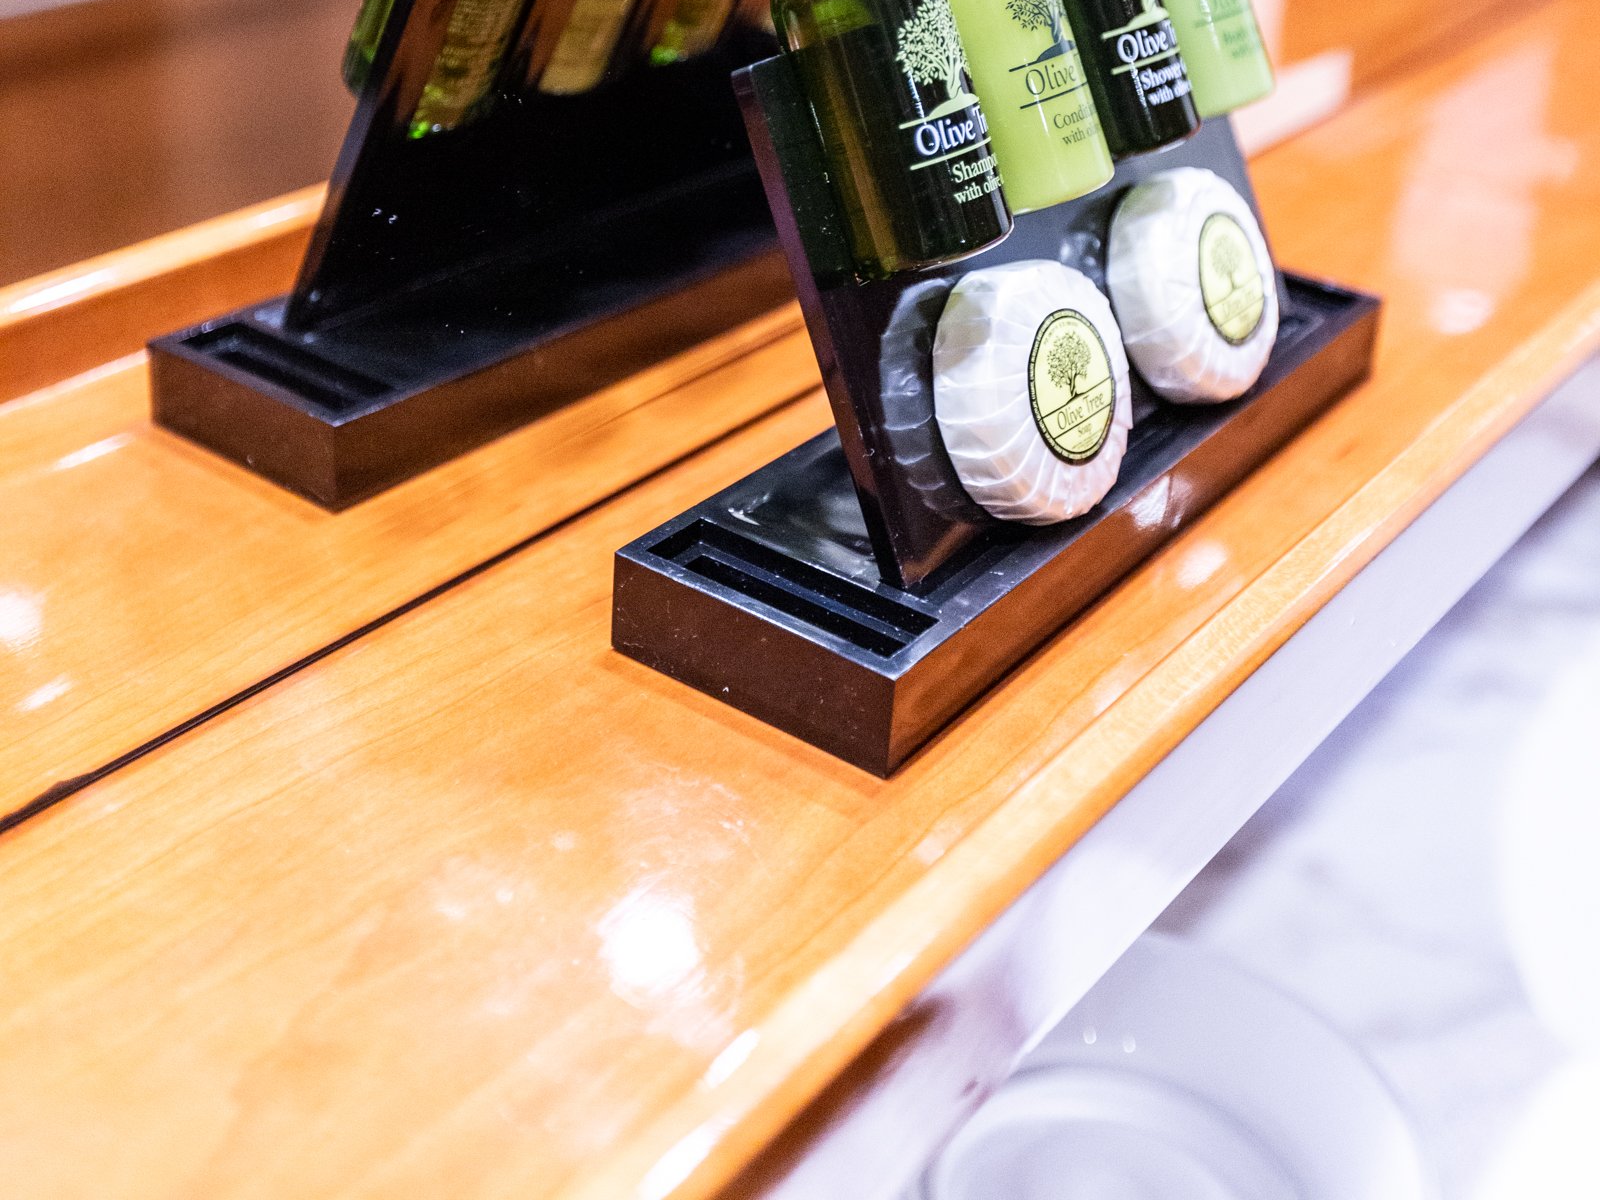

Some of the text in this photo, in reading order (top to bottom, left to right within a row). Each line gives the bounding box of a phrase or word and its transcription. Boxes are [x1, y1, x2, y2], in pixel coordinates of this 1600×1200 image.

[1117, 30, 1169, 63] Olive
[1025, 64, 1077, 95] Olive
[1139, 62, 1182, 90] Shower
[1148, 85, 1175, 106] with
[915, 118, 976, 155] Olive
[1062, 128, 1087, 145] with
[953, 182, 983, 204] with
[1057, 393, 1104, 430] Olive Tree
